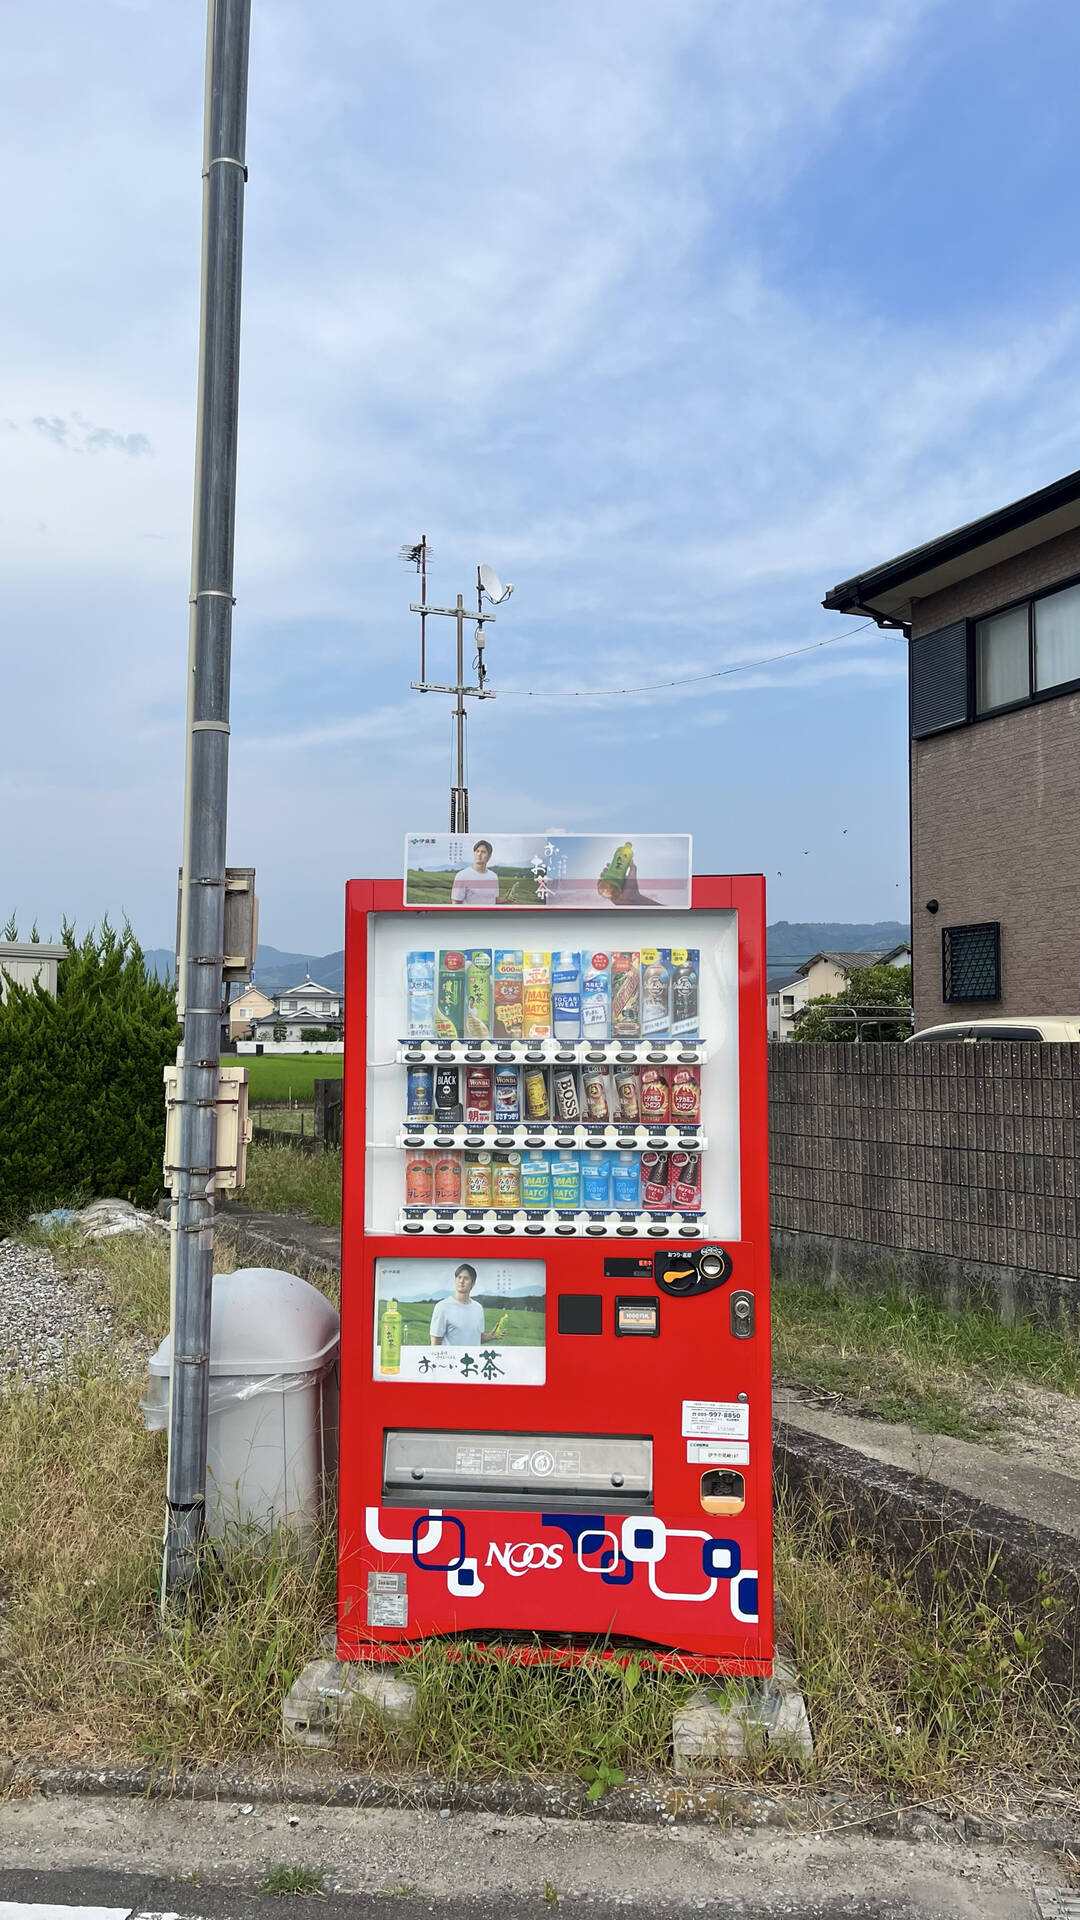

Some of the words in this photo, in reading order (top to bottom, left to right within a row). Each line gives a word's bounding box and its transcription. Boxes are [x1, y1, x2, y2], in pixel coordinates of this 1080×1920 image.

[437, 1075, 457, 1085] BLACK
[561, 1079, 578, 1117] BOSS
[408, 1190, 432, 1199] オレンジ
[436, 1190, 459, 1198] オレンジ
[484, 1541, 564, 1577] NOOS
